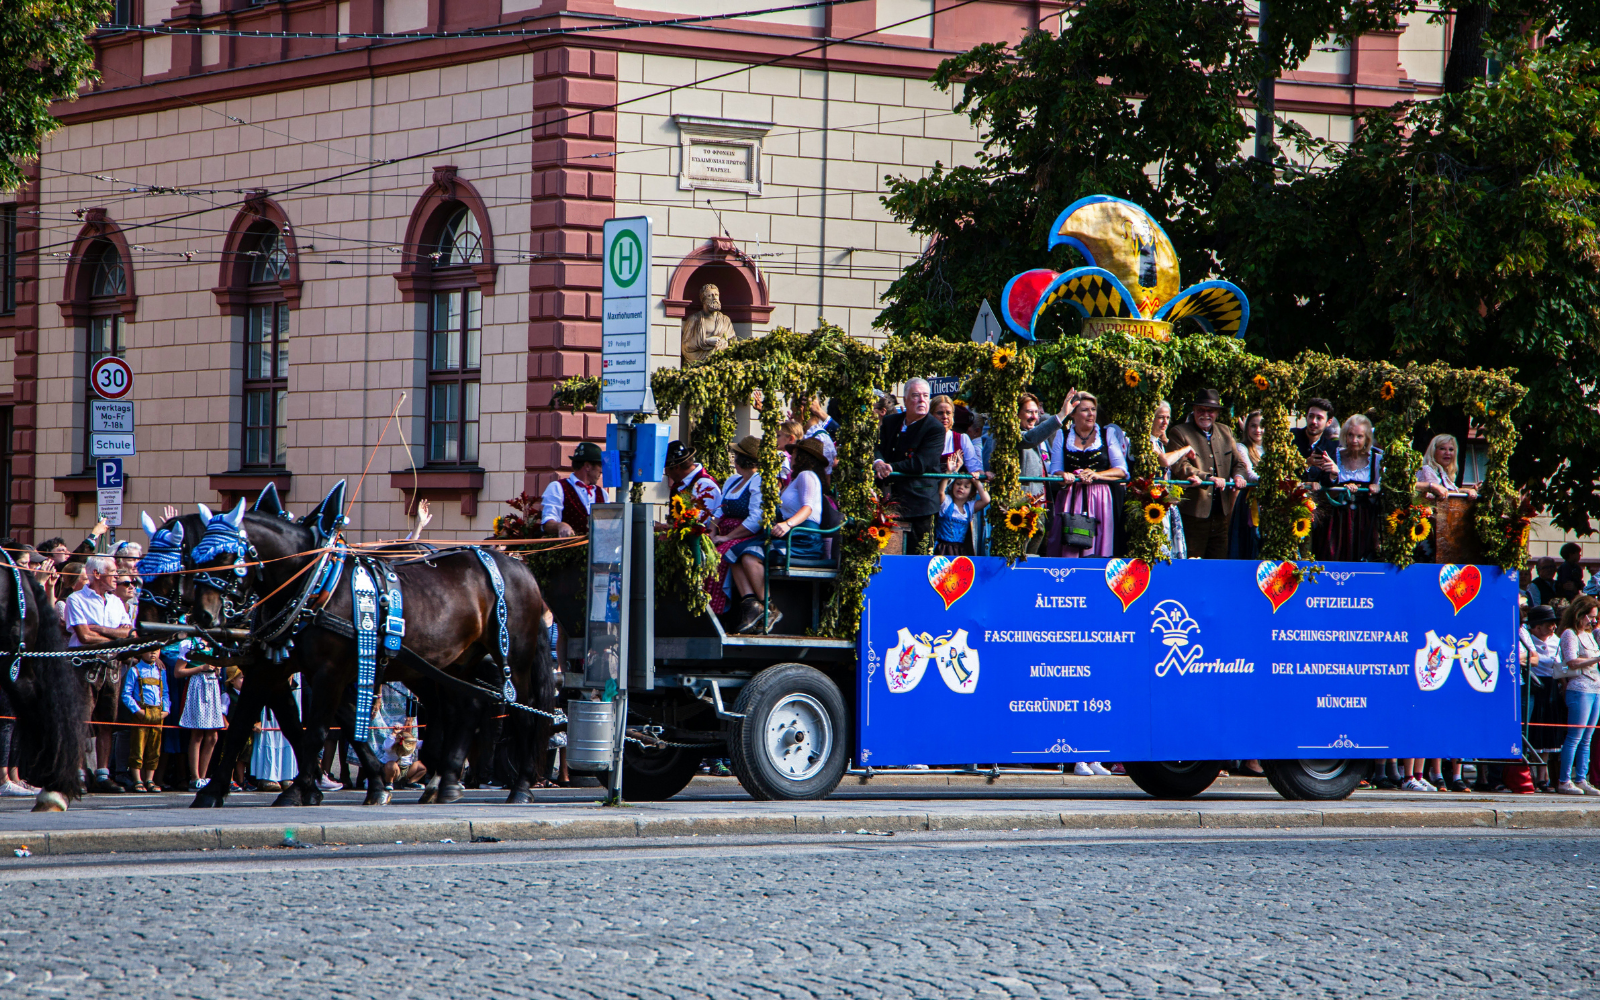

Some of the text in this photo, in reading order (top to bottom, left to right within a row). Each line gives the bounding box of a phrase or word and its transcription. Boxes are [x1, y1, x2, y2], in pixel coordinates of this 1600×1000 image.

[619, 242, 632, 275] H
[101, 369, 124, 387] 30
[95, 404, 131, 413] werktags
[96, 440, 131, 449] Schule
[103, 462, 117, 485] P
[942, 577, 967, 597] Herz
[1035, 593, 1087, 608] ÄLTESTE
[1306, 597, 1374, 609] OFFIZIELLES
[984, 630, 1136, 643] FASCHINGSGESELLSCHAFT
[1271, 629, 1409, 643] FASCHINGSPRINZENPAAR
[1155, 644, 1254, 677] Narrhalla
[1030, 663, 1091, 677] MÜNCHENS
[1272, 663, 1410, 675] DER LANDESHAUPTSTADT
[1009, 697, 1112, 713] GEGRÜNDET 1893
[1316, 694, 1367, 708] MÜNCHEN
